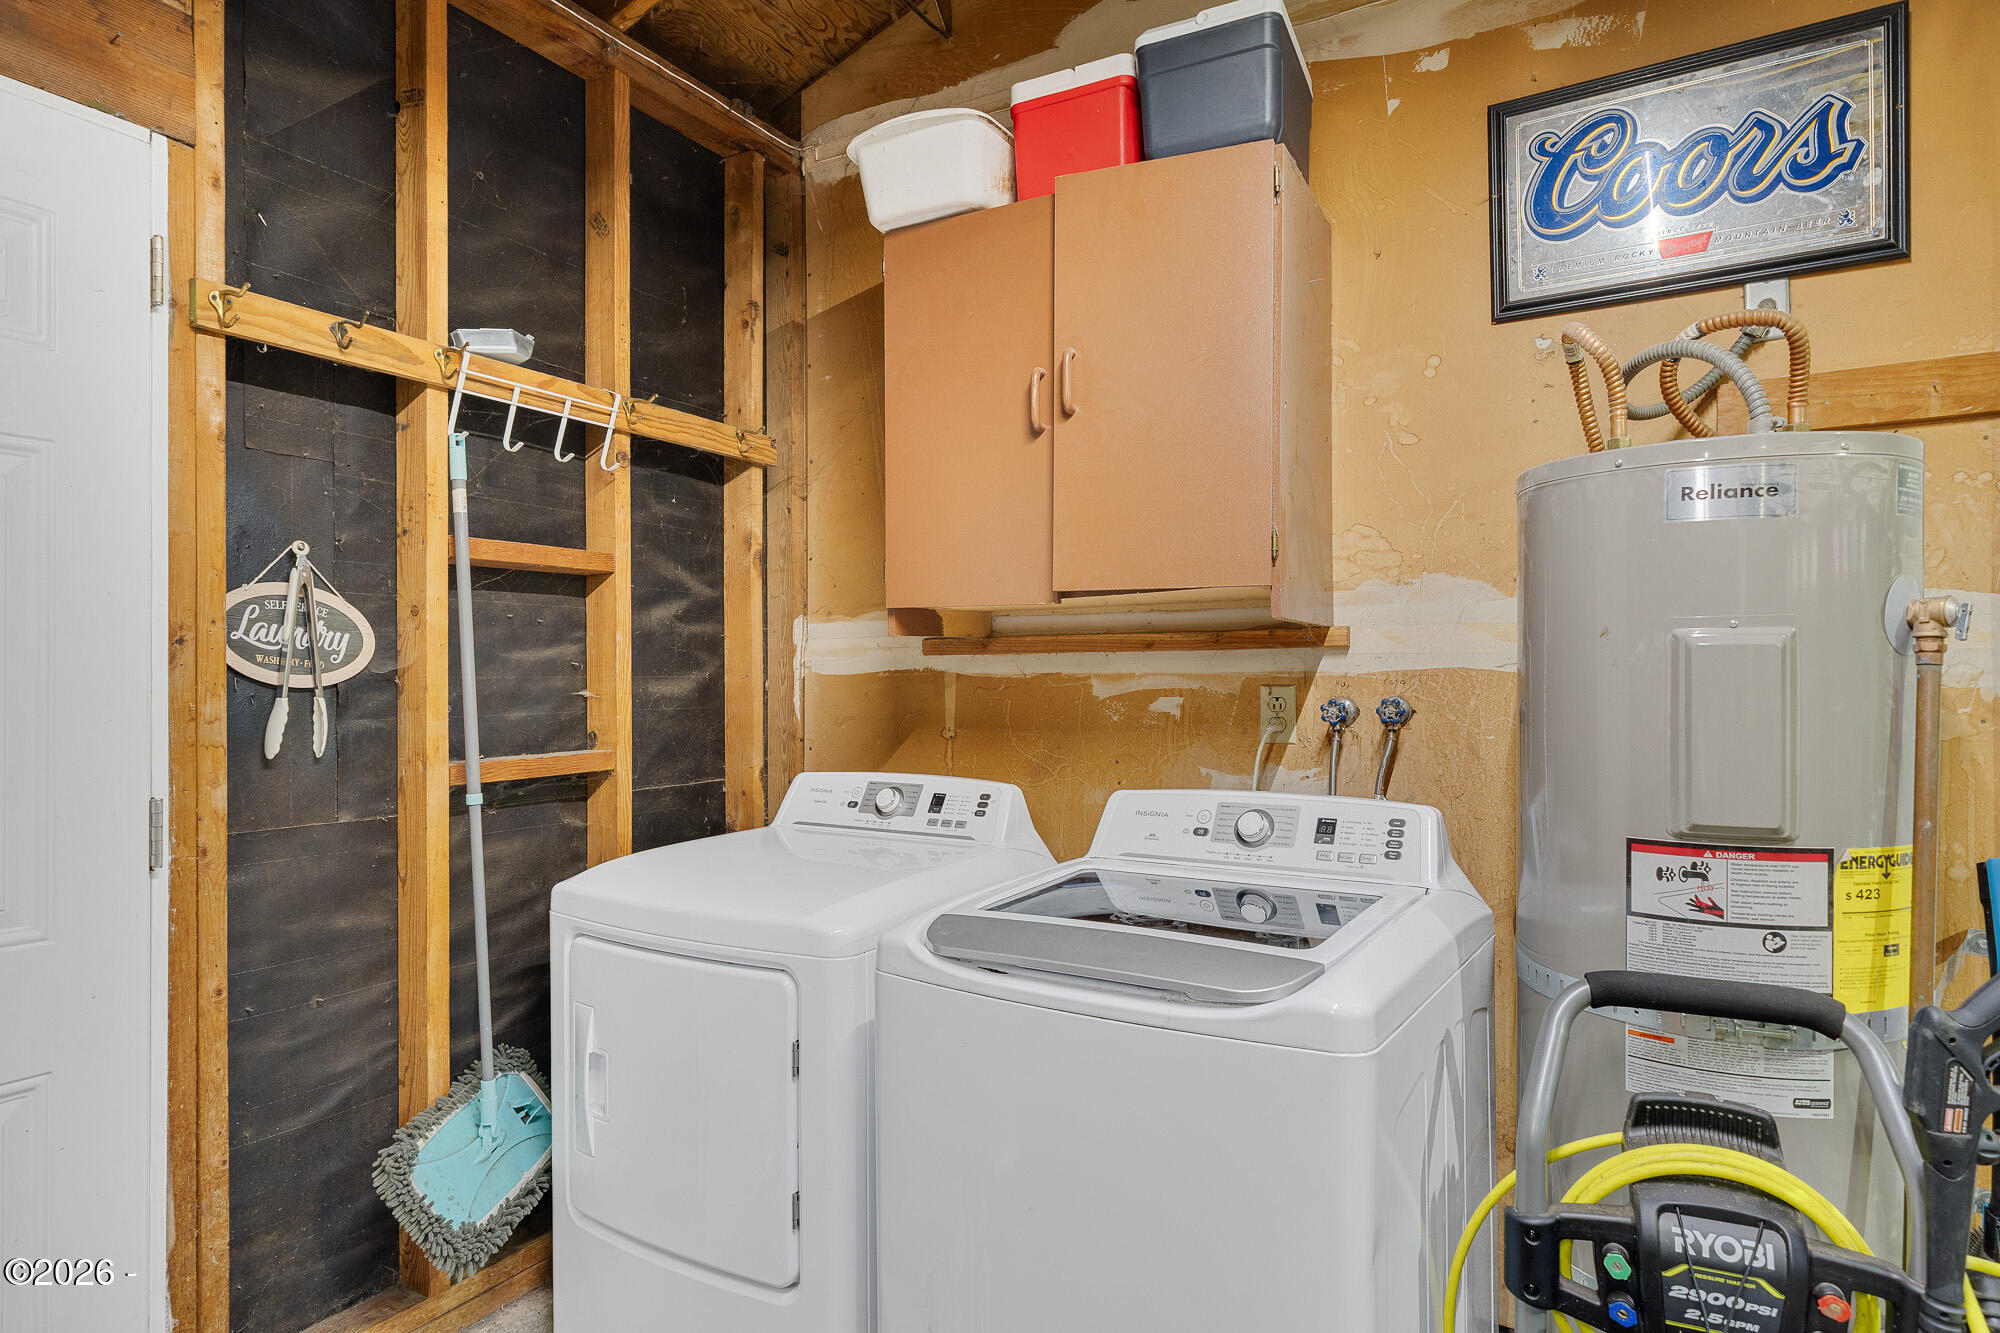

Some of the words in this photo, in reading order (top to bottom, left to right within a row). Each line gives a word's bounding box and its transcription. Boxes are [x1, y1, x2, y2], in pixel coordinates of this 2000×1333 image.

[1523, 92, 1868, 242] Coors
[1714, 224, 1786, 244] MOUNTAIN
[1615, 249, 1654, 262] ROCKY
[1681, 483, 1779, 502] Reliance
[1135, 810, 1169, 818] INSIGNIA
[1715, 851, 1756, 860] DANGER
[1840, 851, 1912, 870] ENERGYGUID
[1856, 888, 1880, 900] 423
[1672, 1226, 1775, 1271] RYOBI
